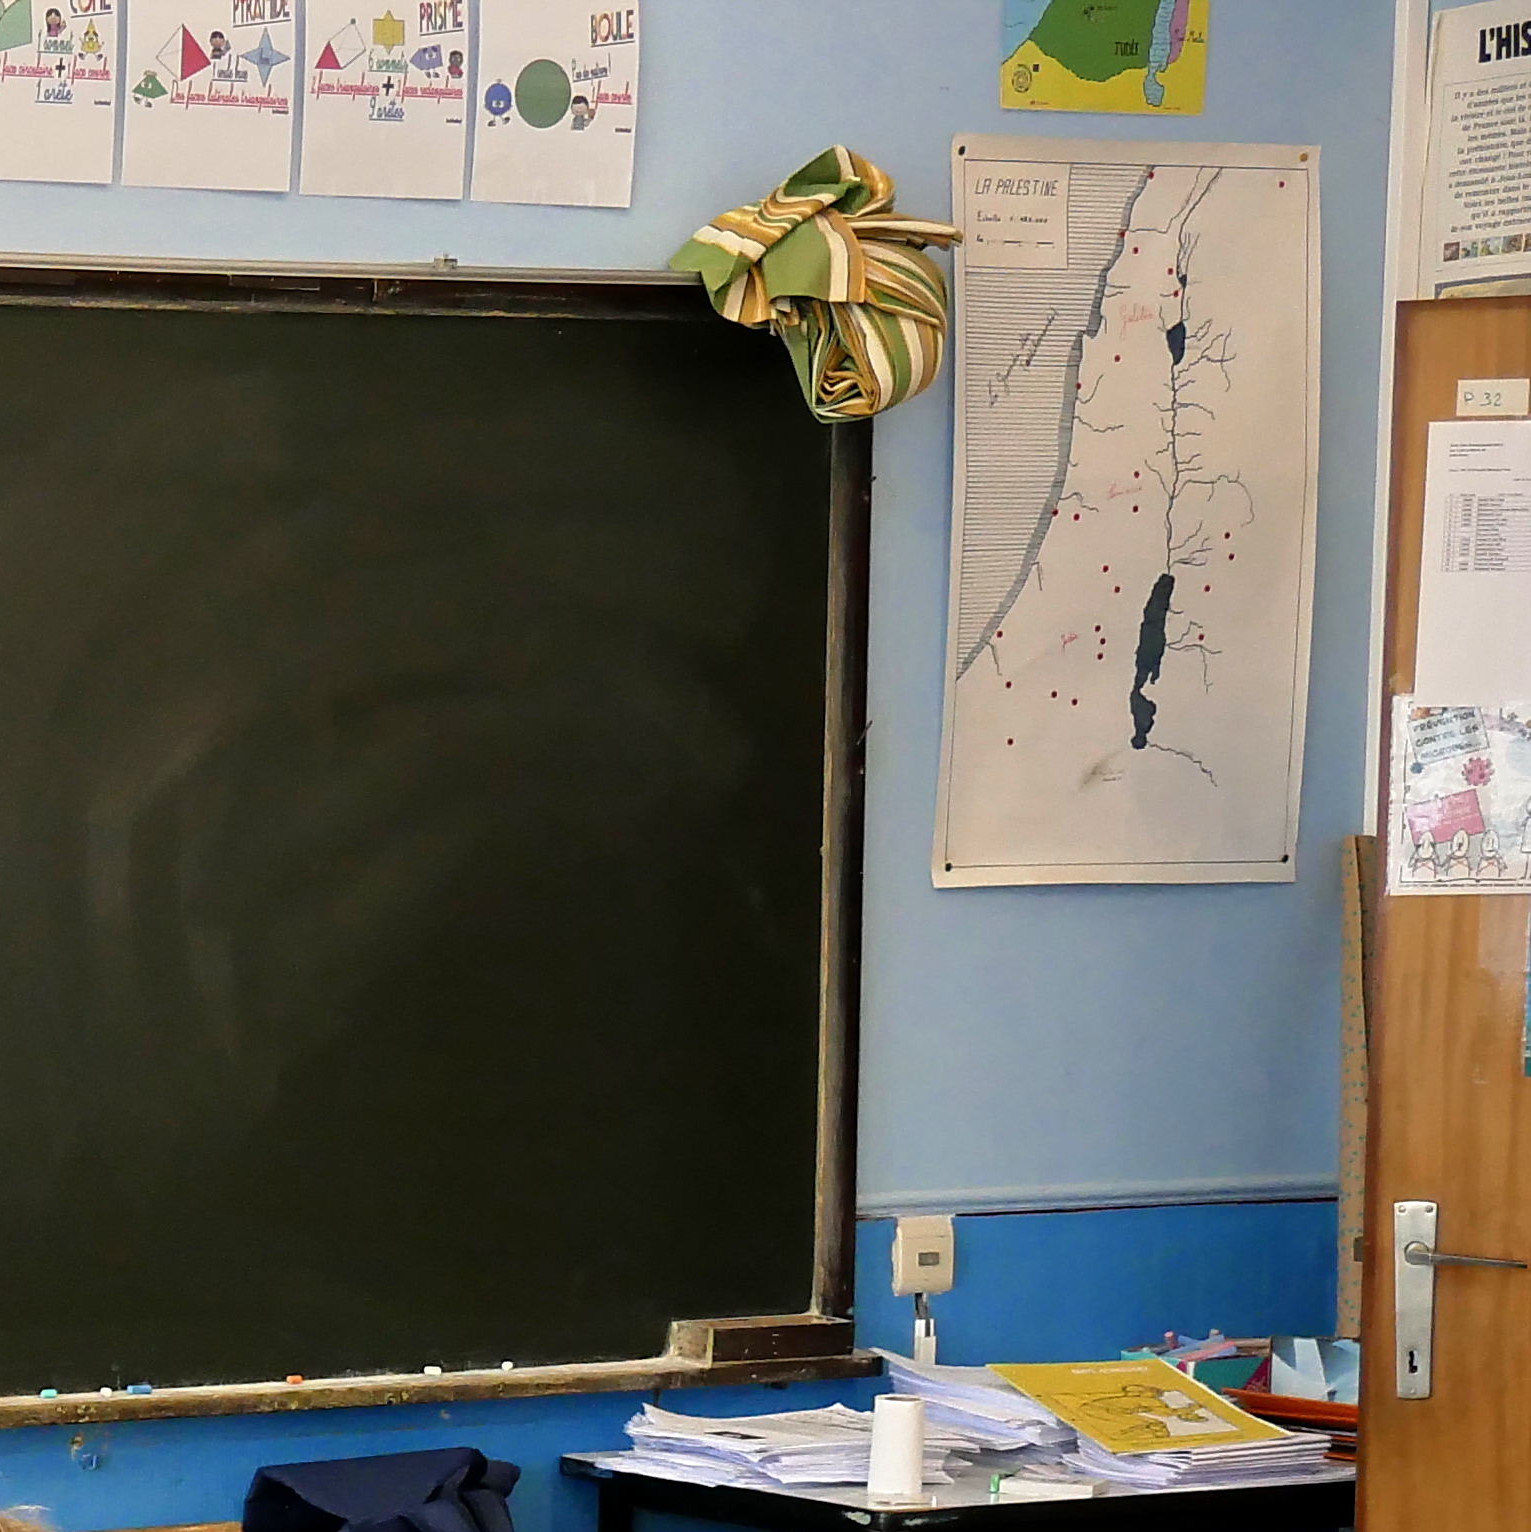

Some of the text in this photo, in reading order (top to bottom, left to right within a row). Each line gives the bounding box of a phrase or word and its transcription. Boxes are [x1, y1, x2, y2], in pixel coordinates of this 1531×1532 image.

[419, 0, 463, 32] PRISME
[591, 10, 635, 44] BOULE
[1478, 20, 1531, 63] L'HIS
[975, 178, 1059, 197] LA PALESTINE
[1480, 392, 1502, 407] 32
[1459, 723, 1480, 736] LES
